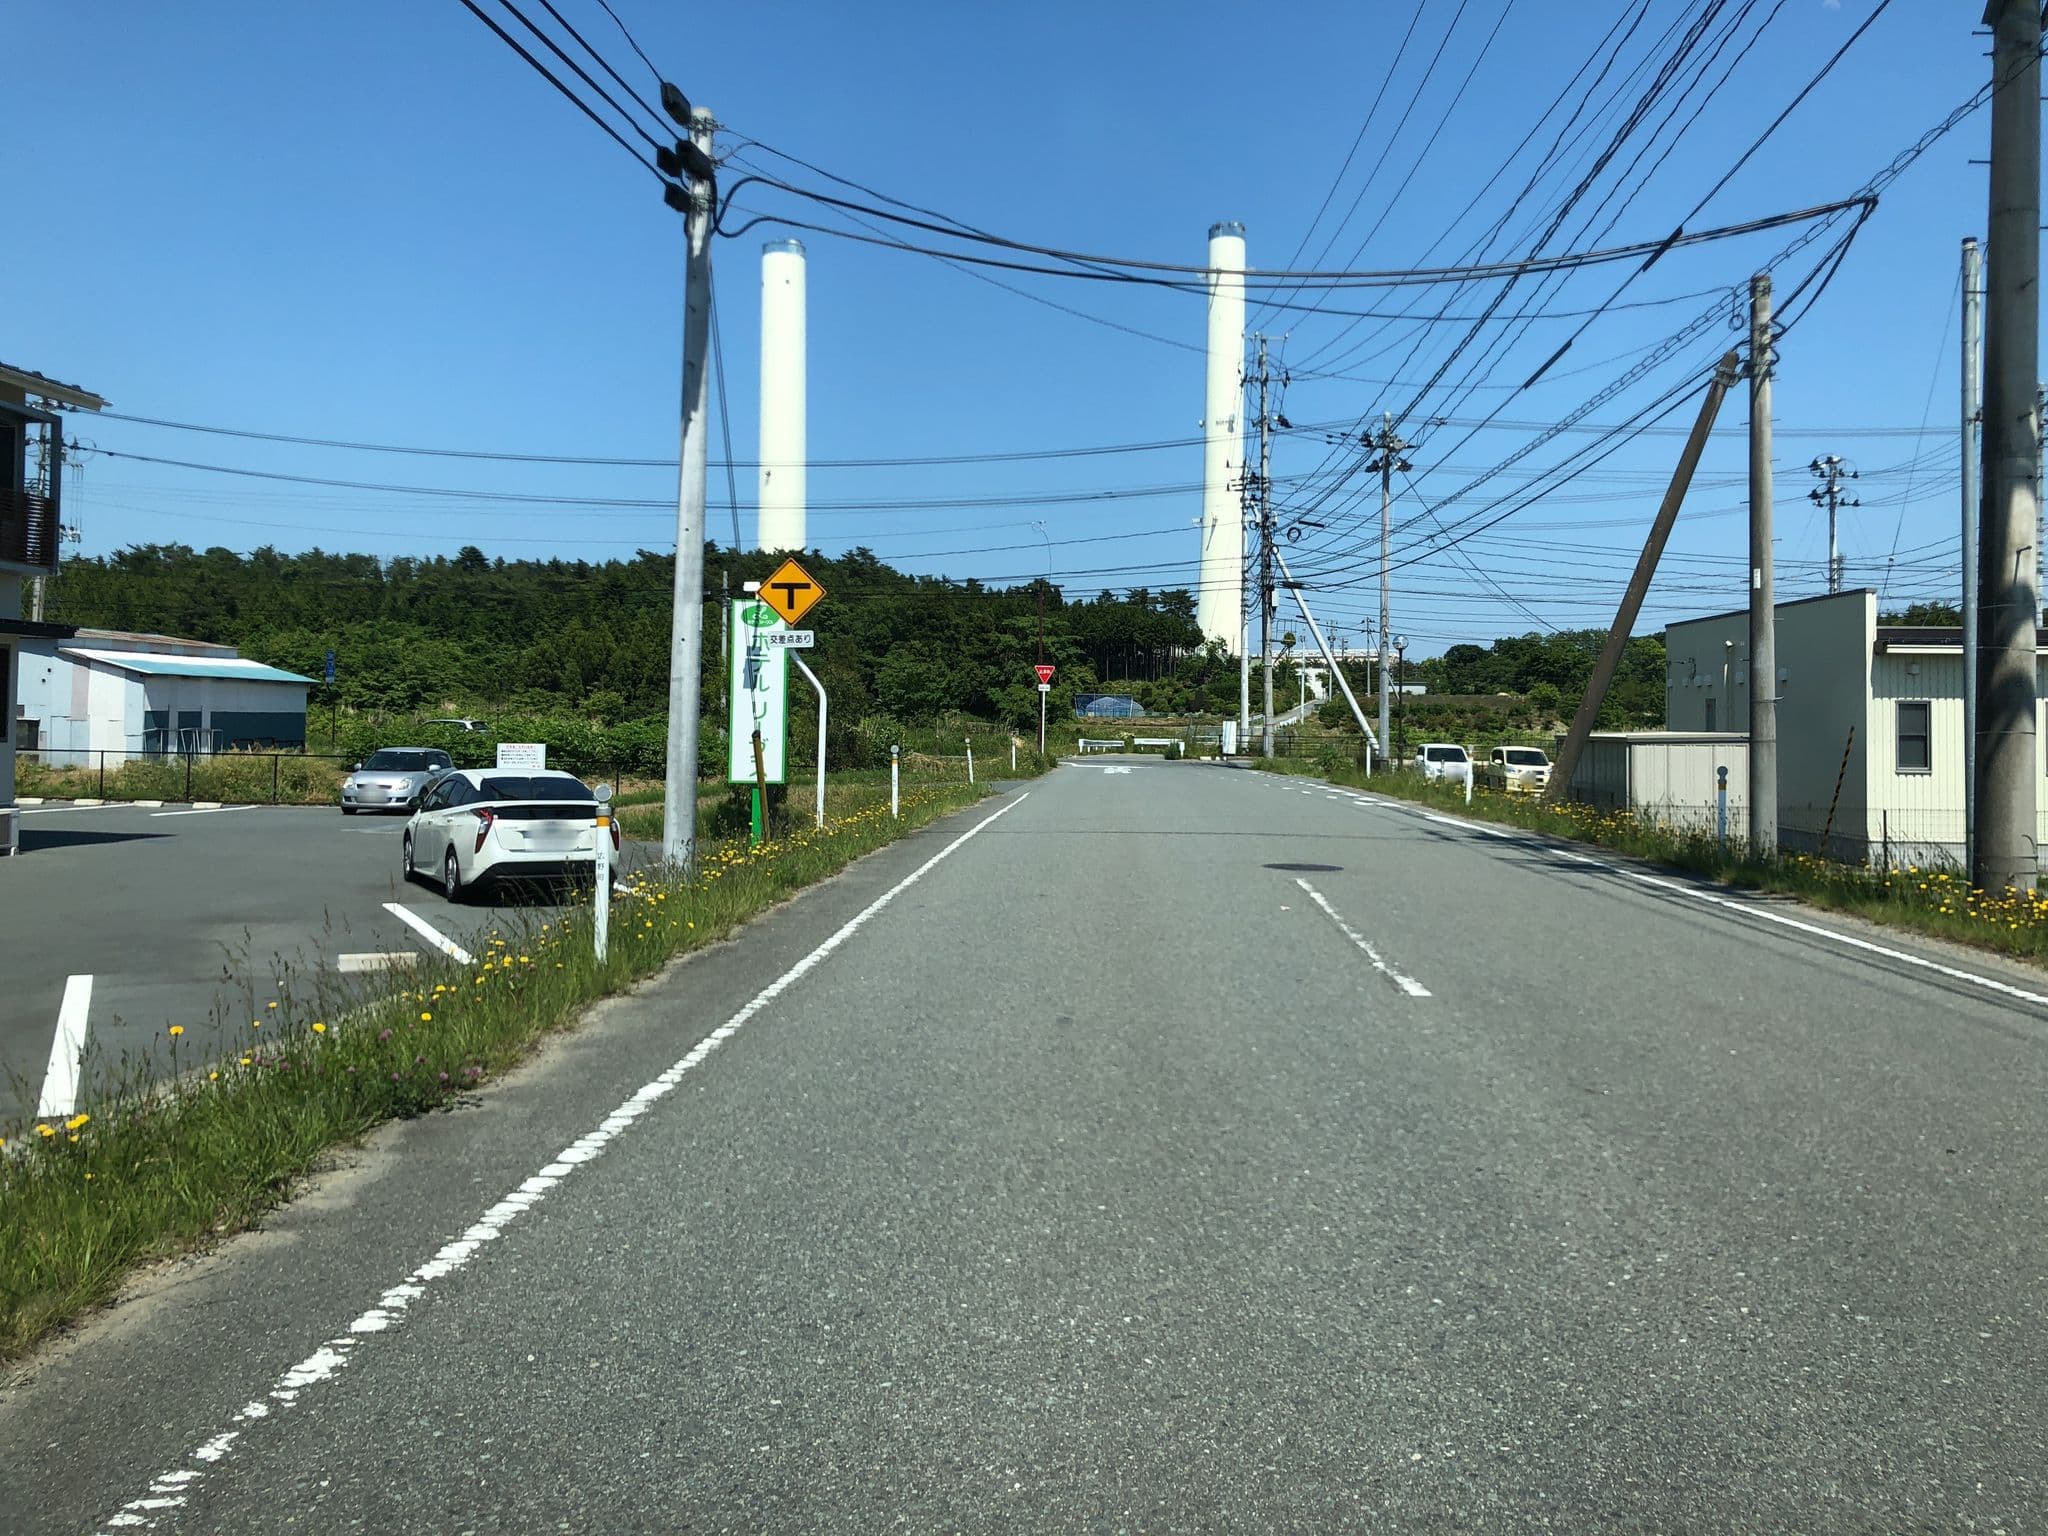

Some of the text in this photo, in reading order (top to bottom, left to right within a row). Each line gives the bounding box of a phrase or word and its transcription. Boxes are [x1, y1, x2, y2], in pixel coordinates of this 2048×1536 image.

[770, 634, 811, 645] 交差点あり
[751, 632, 770, 692] ホテル
